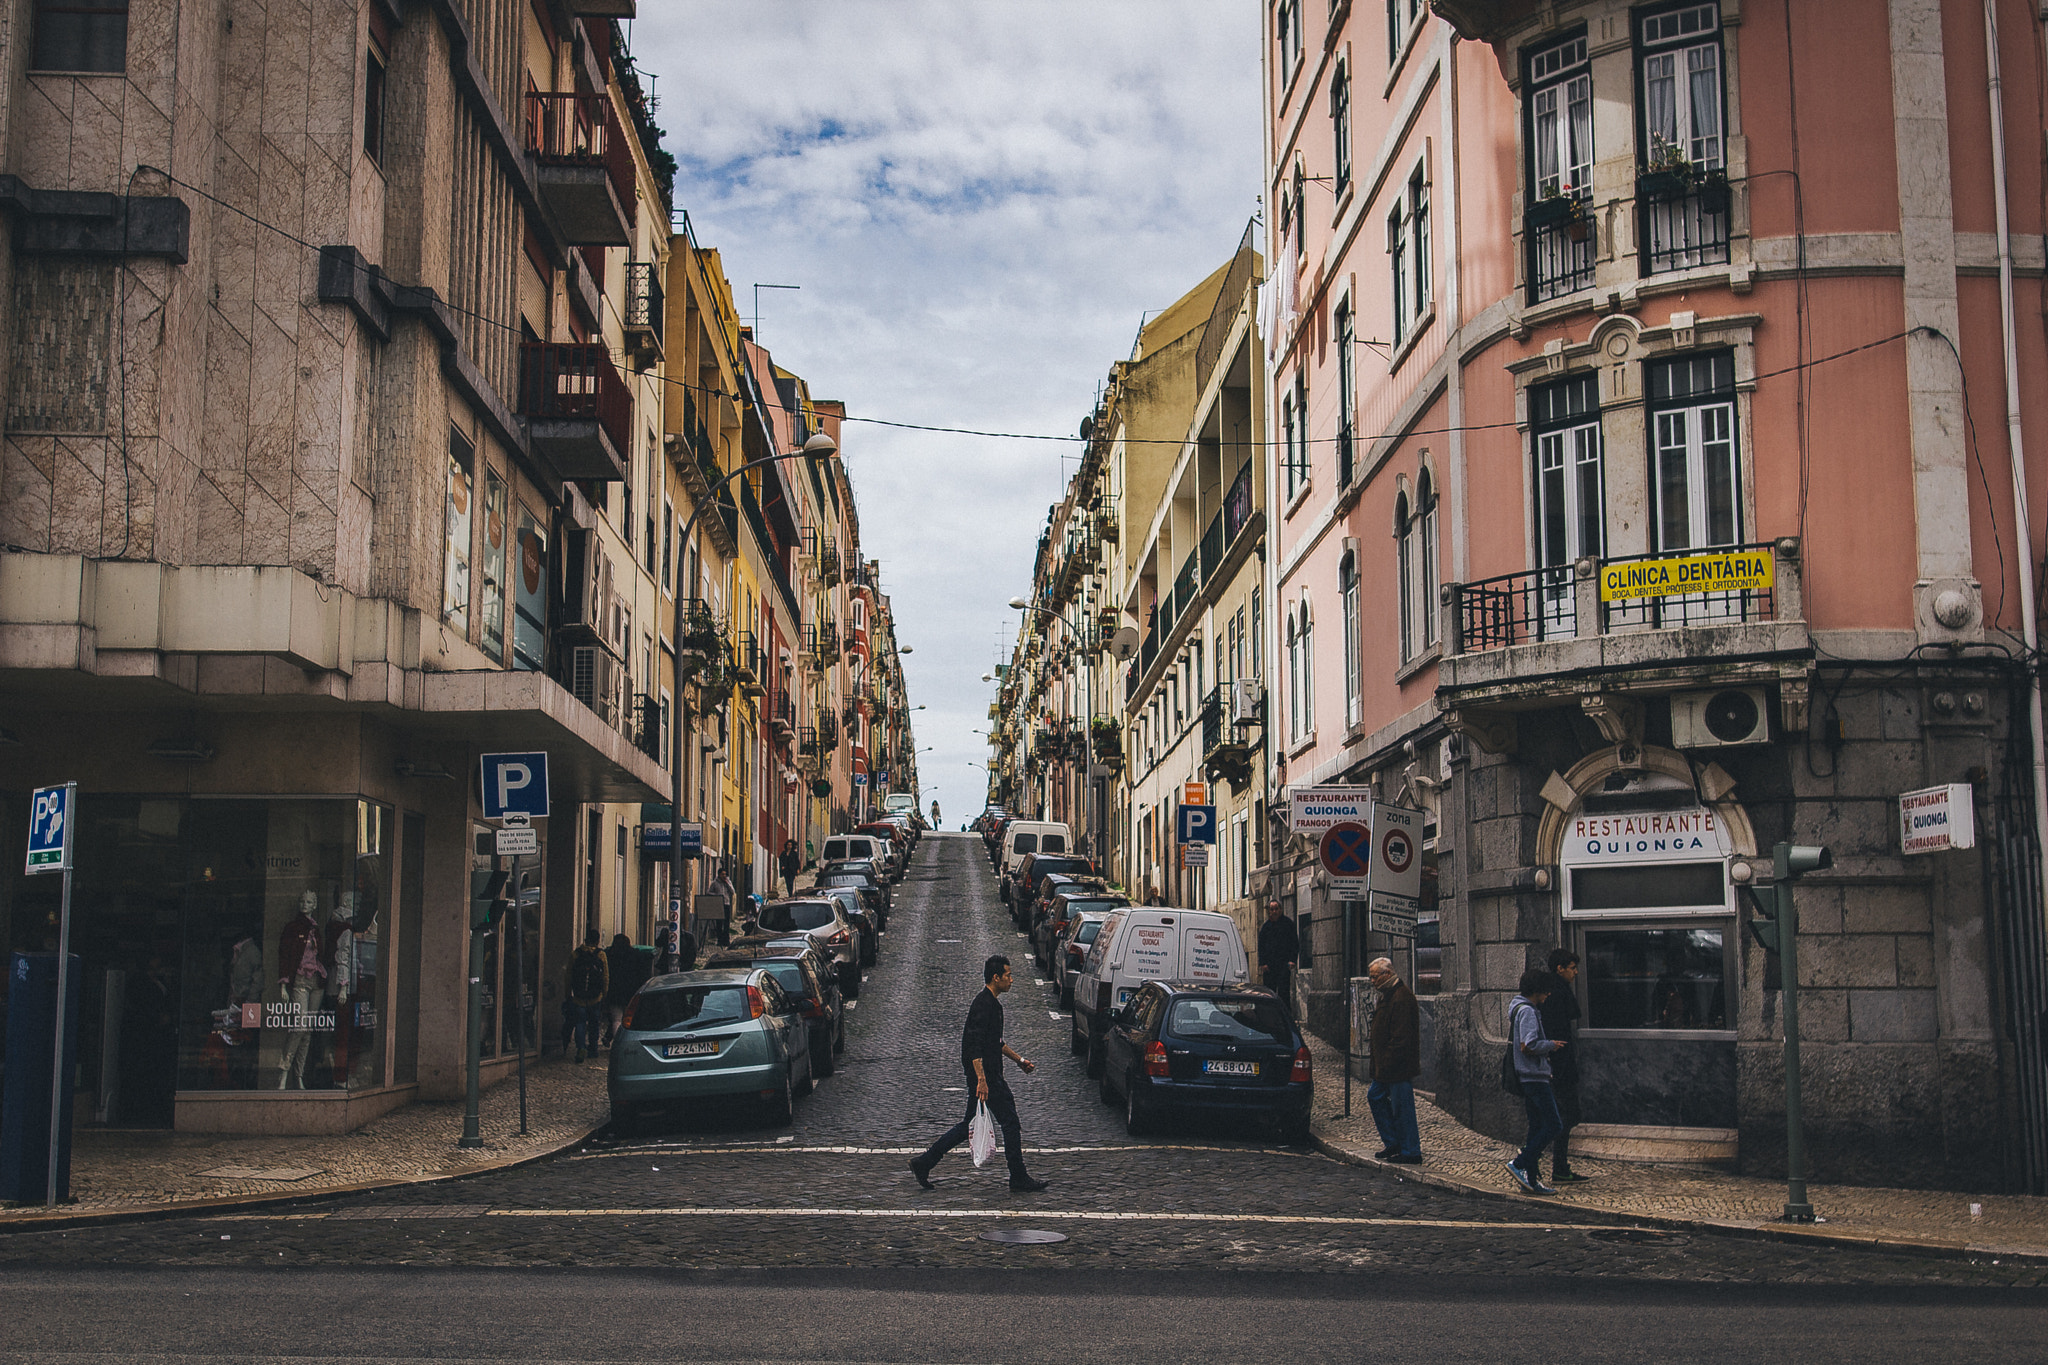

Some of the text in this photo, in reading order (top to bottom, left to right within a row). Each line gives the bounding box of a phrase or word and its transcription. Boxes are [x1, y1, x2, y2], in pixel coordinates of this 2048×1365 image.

[1607, 556, 1765, 589] CLÍNICA DENTÁRIA
[1612, 590, 1632, 599] BOCA,
[1666, 582, 1702, 594] PRÓTESES
[1705, 582, 1709, 590] E
[1713, 578, 1760, 590] ORTODONTIA
[497, 763, 532, 808] P
[1296, 794, 1367, 802] RESTAURANTE
[1902, 792, 1949, 810] RESTAURANTE
[34, 797, 49, 834] P
[1304, 806, 1358, 816] QUIONGA
[1913, 811, 1948, 829] QUIONGA
[1186, 810, 1207, 838] P
[1296, 819, 1332, 827] FRANGOS
[1576, 813, 1714, 838] RESTAURANTE
[1587, 836, 1703, 854] QUIONGA
[1904, 833, 1951, 850] CHURRASQUEIRA
[1138, 930, 1165, 939] RESTAURANTE
[266, 1002, 301, 1015] YOUR
[266, 1015, 336, 1028] COLLECTION
